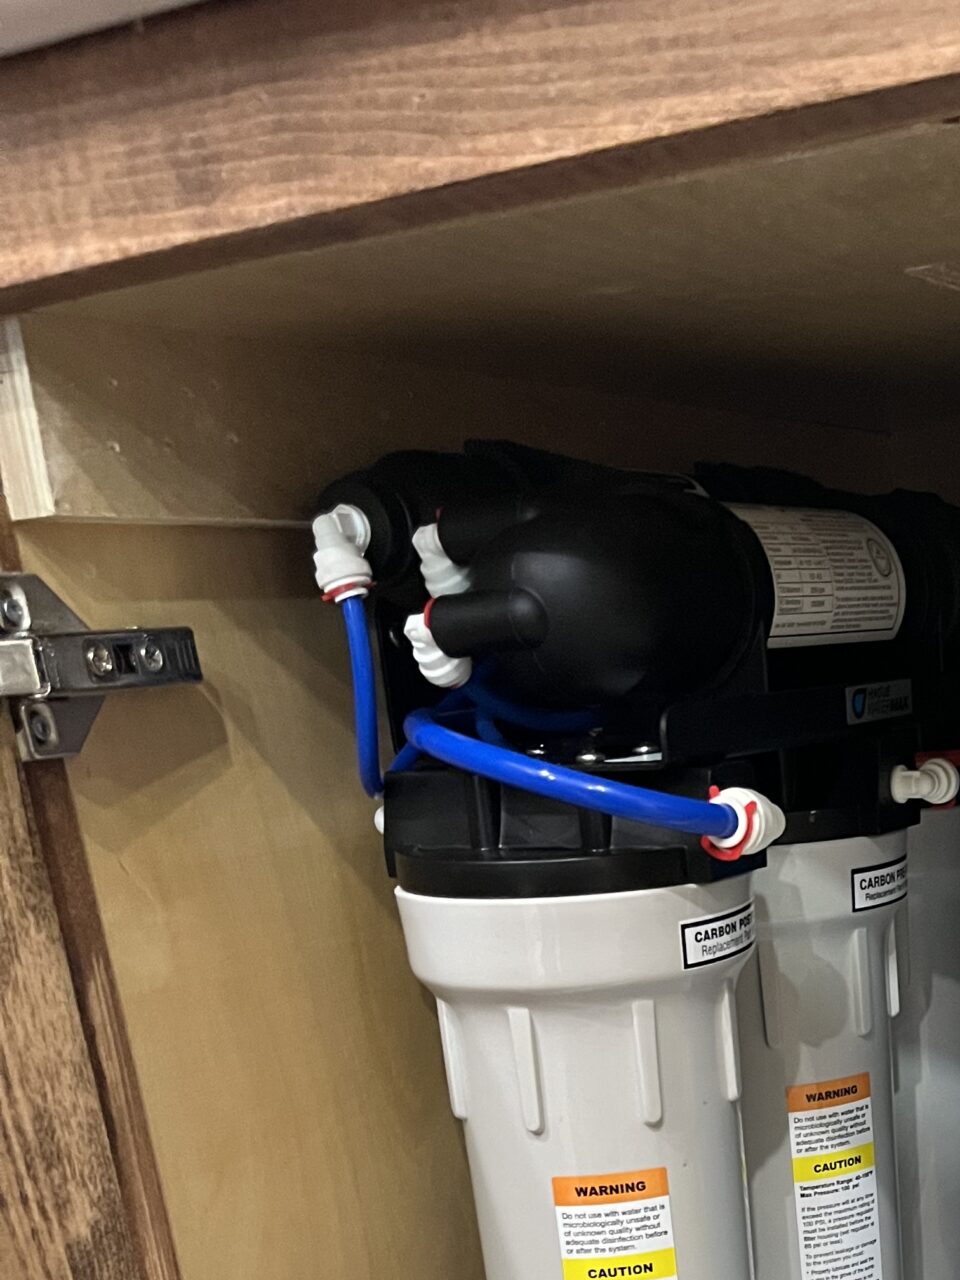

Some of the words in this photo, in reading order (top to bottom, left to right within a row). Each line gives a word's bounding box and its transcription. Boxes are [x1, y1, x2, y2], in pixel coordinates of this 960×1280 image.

[860, 872, 895, 890] CARBON
[695, 921, 737, 943] CARBON
[702, 934, 743, 957] Replacement
[806, 1085, 857, 1102] WARNING
[814, 1155, 862, 1173] CAUTION
[575, 1181, 646, 1197] WARNING
[588, 1263, 653, 1278] CAUTION
